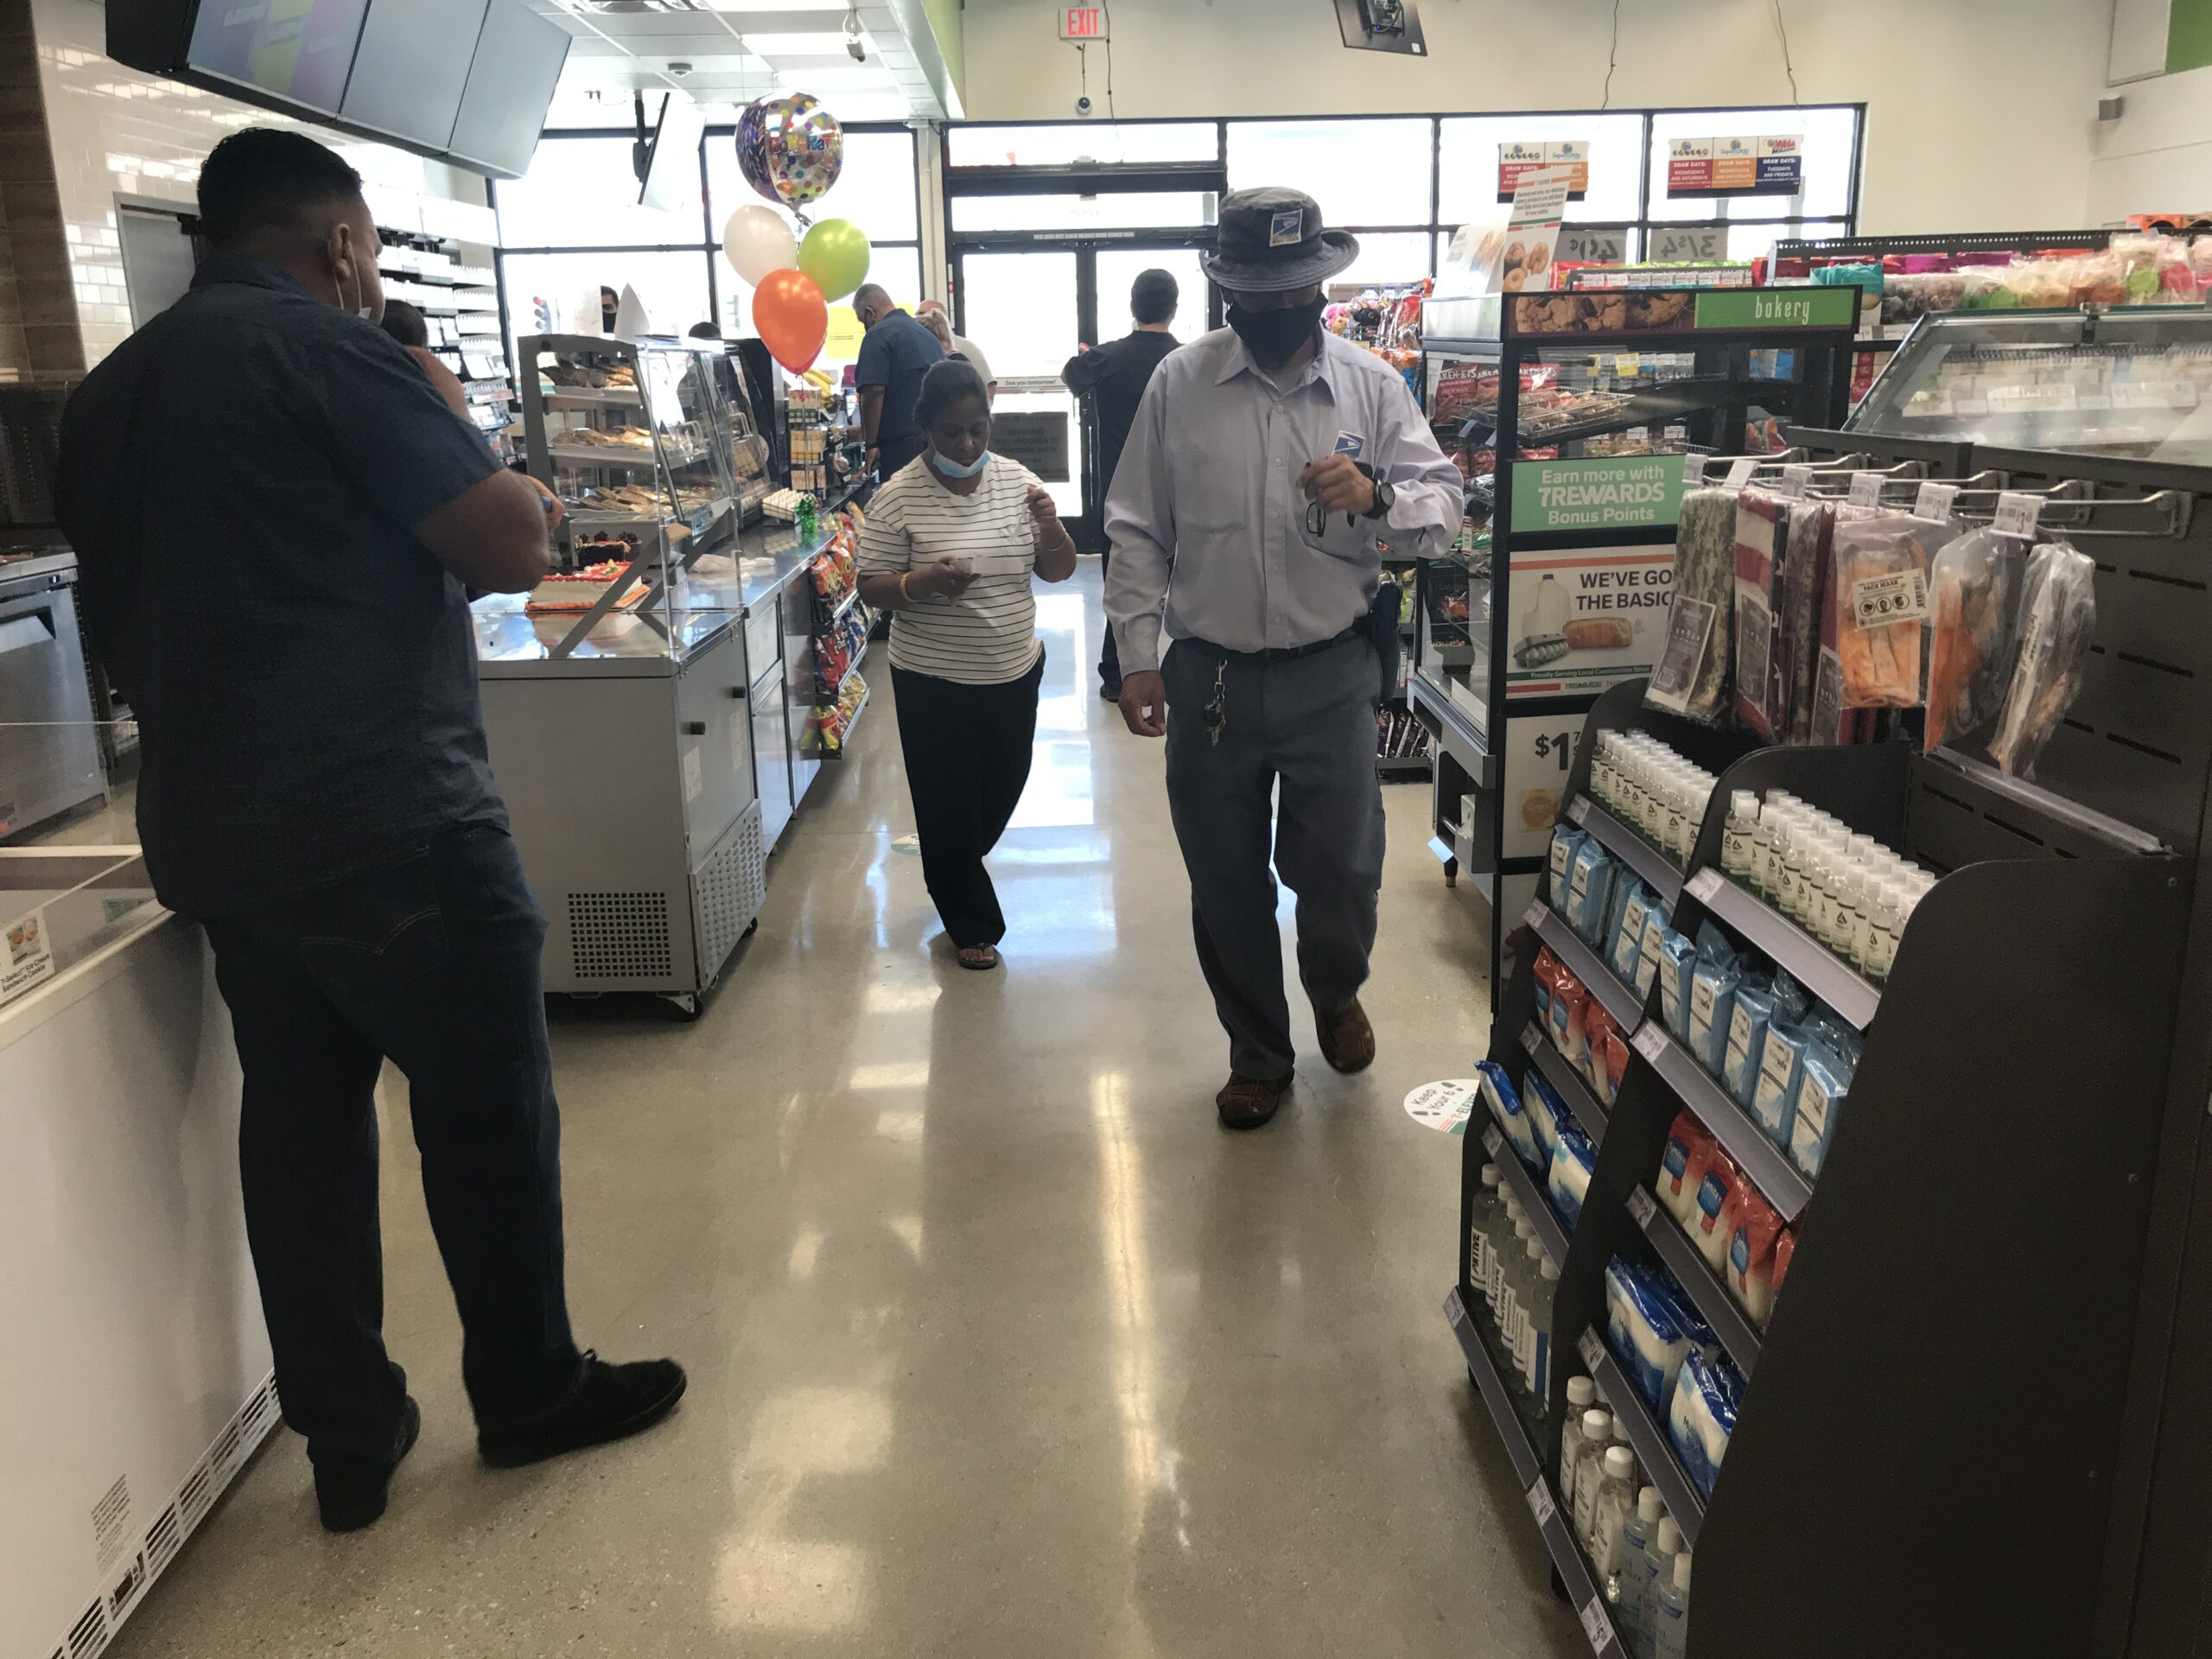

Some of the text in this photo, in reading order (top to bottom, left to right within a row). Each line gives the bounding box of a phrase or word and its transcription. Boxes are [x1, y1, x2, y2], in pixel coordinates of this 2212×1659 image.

[1067, 9, 1099, 35] EXIT
[1755, 295, 1811, 325] bakery
[1541, 465, 1664, 485] Earn more with
[1537, 481, 1665, 507] 7REWARDS
[1548, 505, 1656, 525] Bonus Points
[1580, 569, 1674, 589] WE'VE GO
[1880, 579, 1899, 588] MASK
[1575, 591, 1672, 611] THE BASIC
[1410, 1088, 1439, 1106] Keep
[1426, 1096, 1450, 1110] Your
